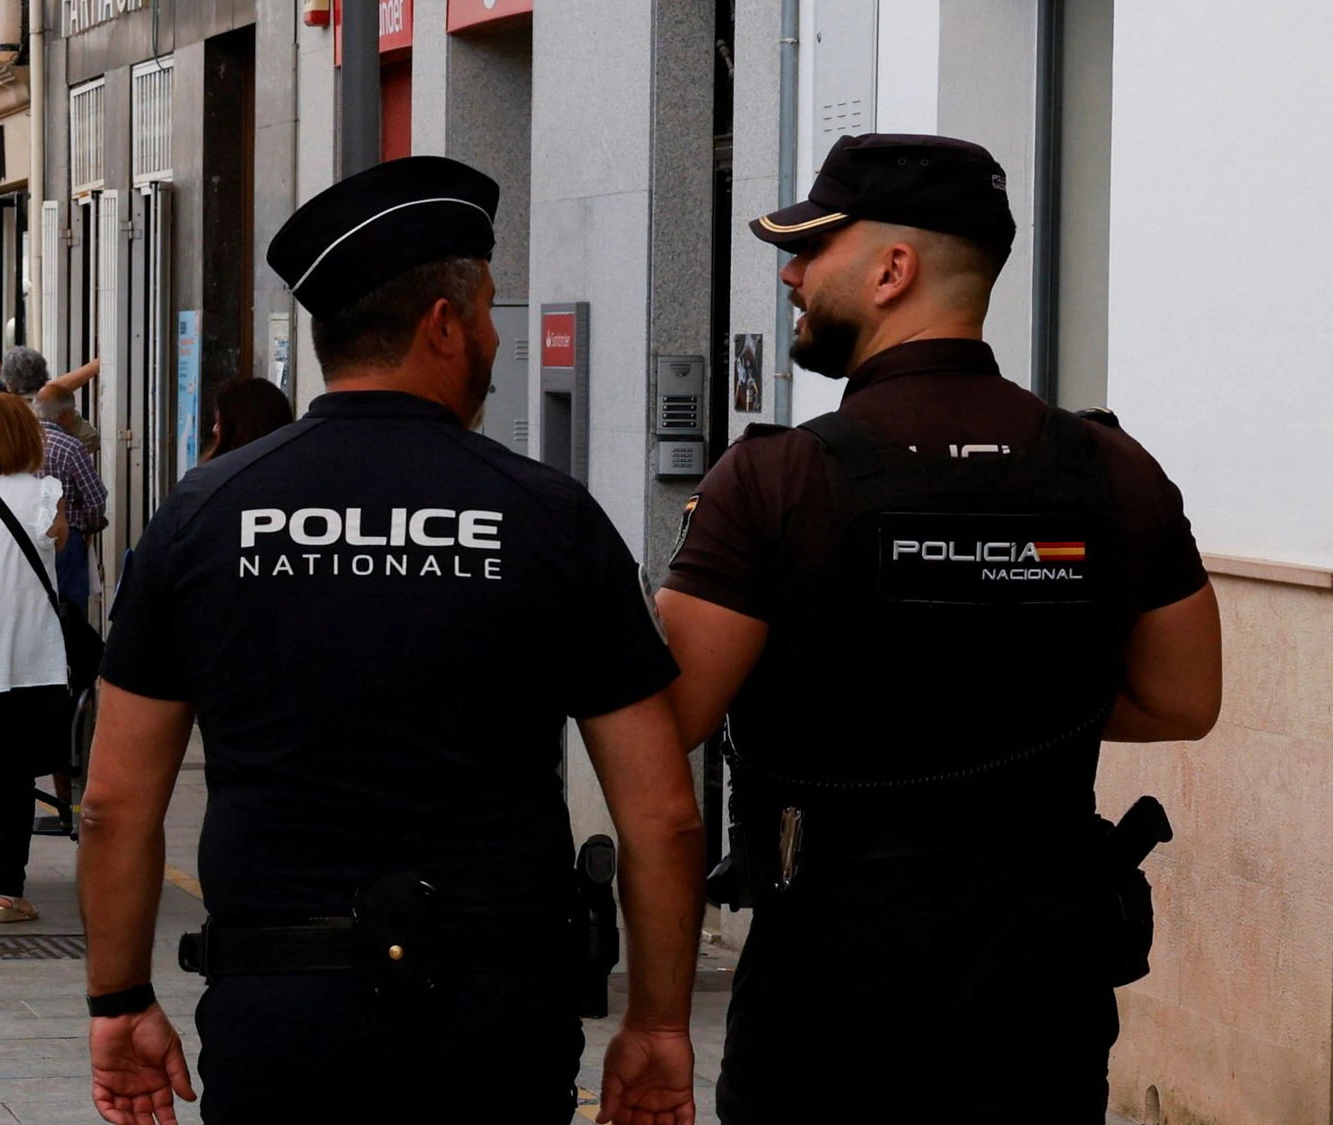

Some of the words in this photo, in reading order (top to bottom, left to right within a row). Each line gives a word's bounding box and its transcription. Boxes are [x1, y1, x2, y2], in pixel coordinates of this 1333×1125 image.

[240, 507, 503, 550] POLICE
[239, 553, 502, 580] NATIONALE
[981, 568, 1083, 580] NACIONAL
